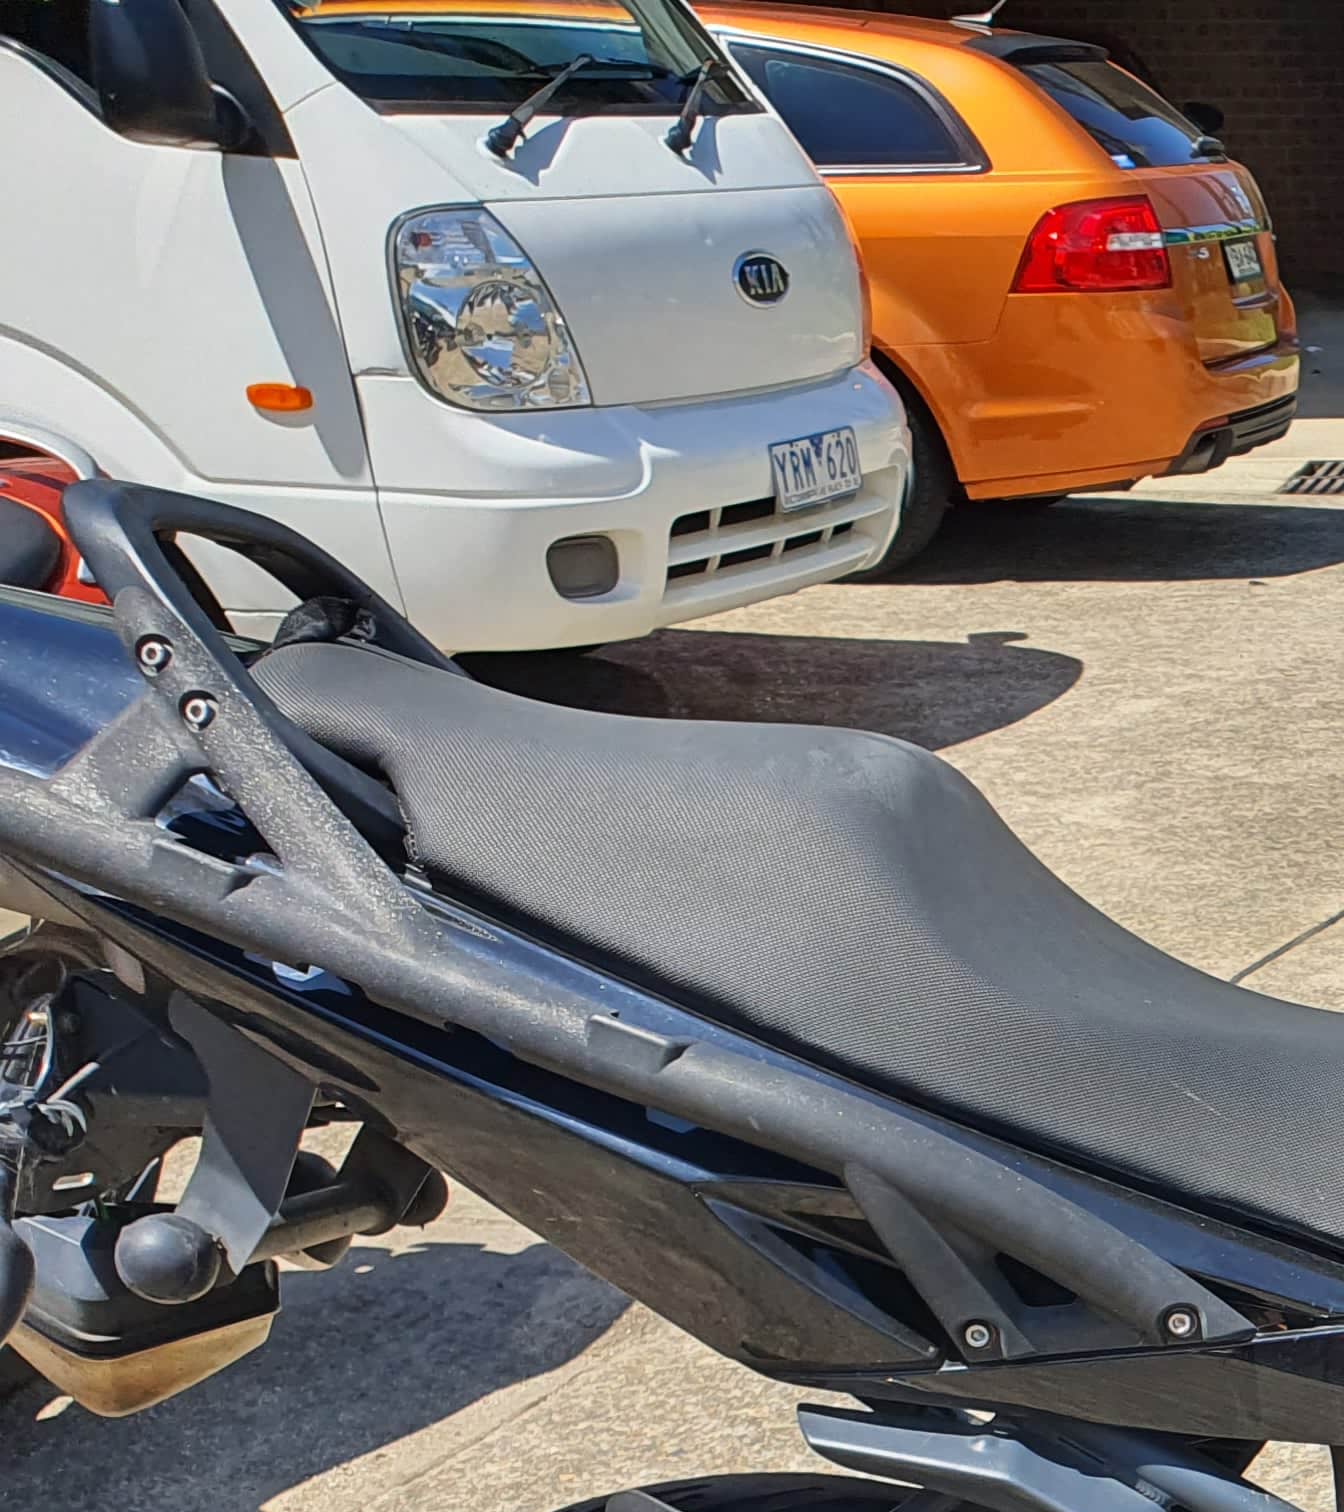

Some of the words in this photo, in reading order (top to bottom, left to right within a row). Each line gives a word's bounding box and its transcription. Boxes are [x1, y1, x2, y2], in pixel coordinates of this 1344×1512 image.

[743, 263, 785, 295] KIA
[773, 446, 818, 494] YRM
[826, 436, 857, 480] 620
